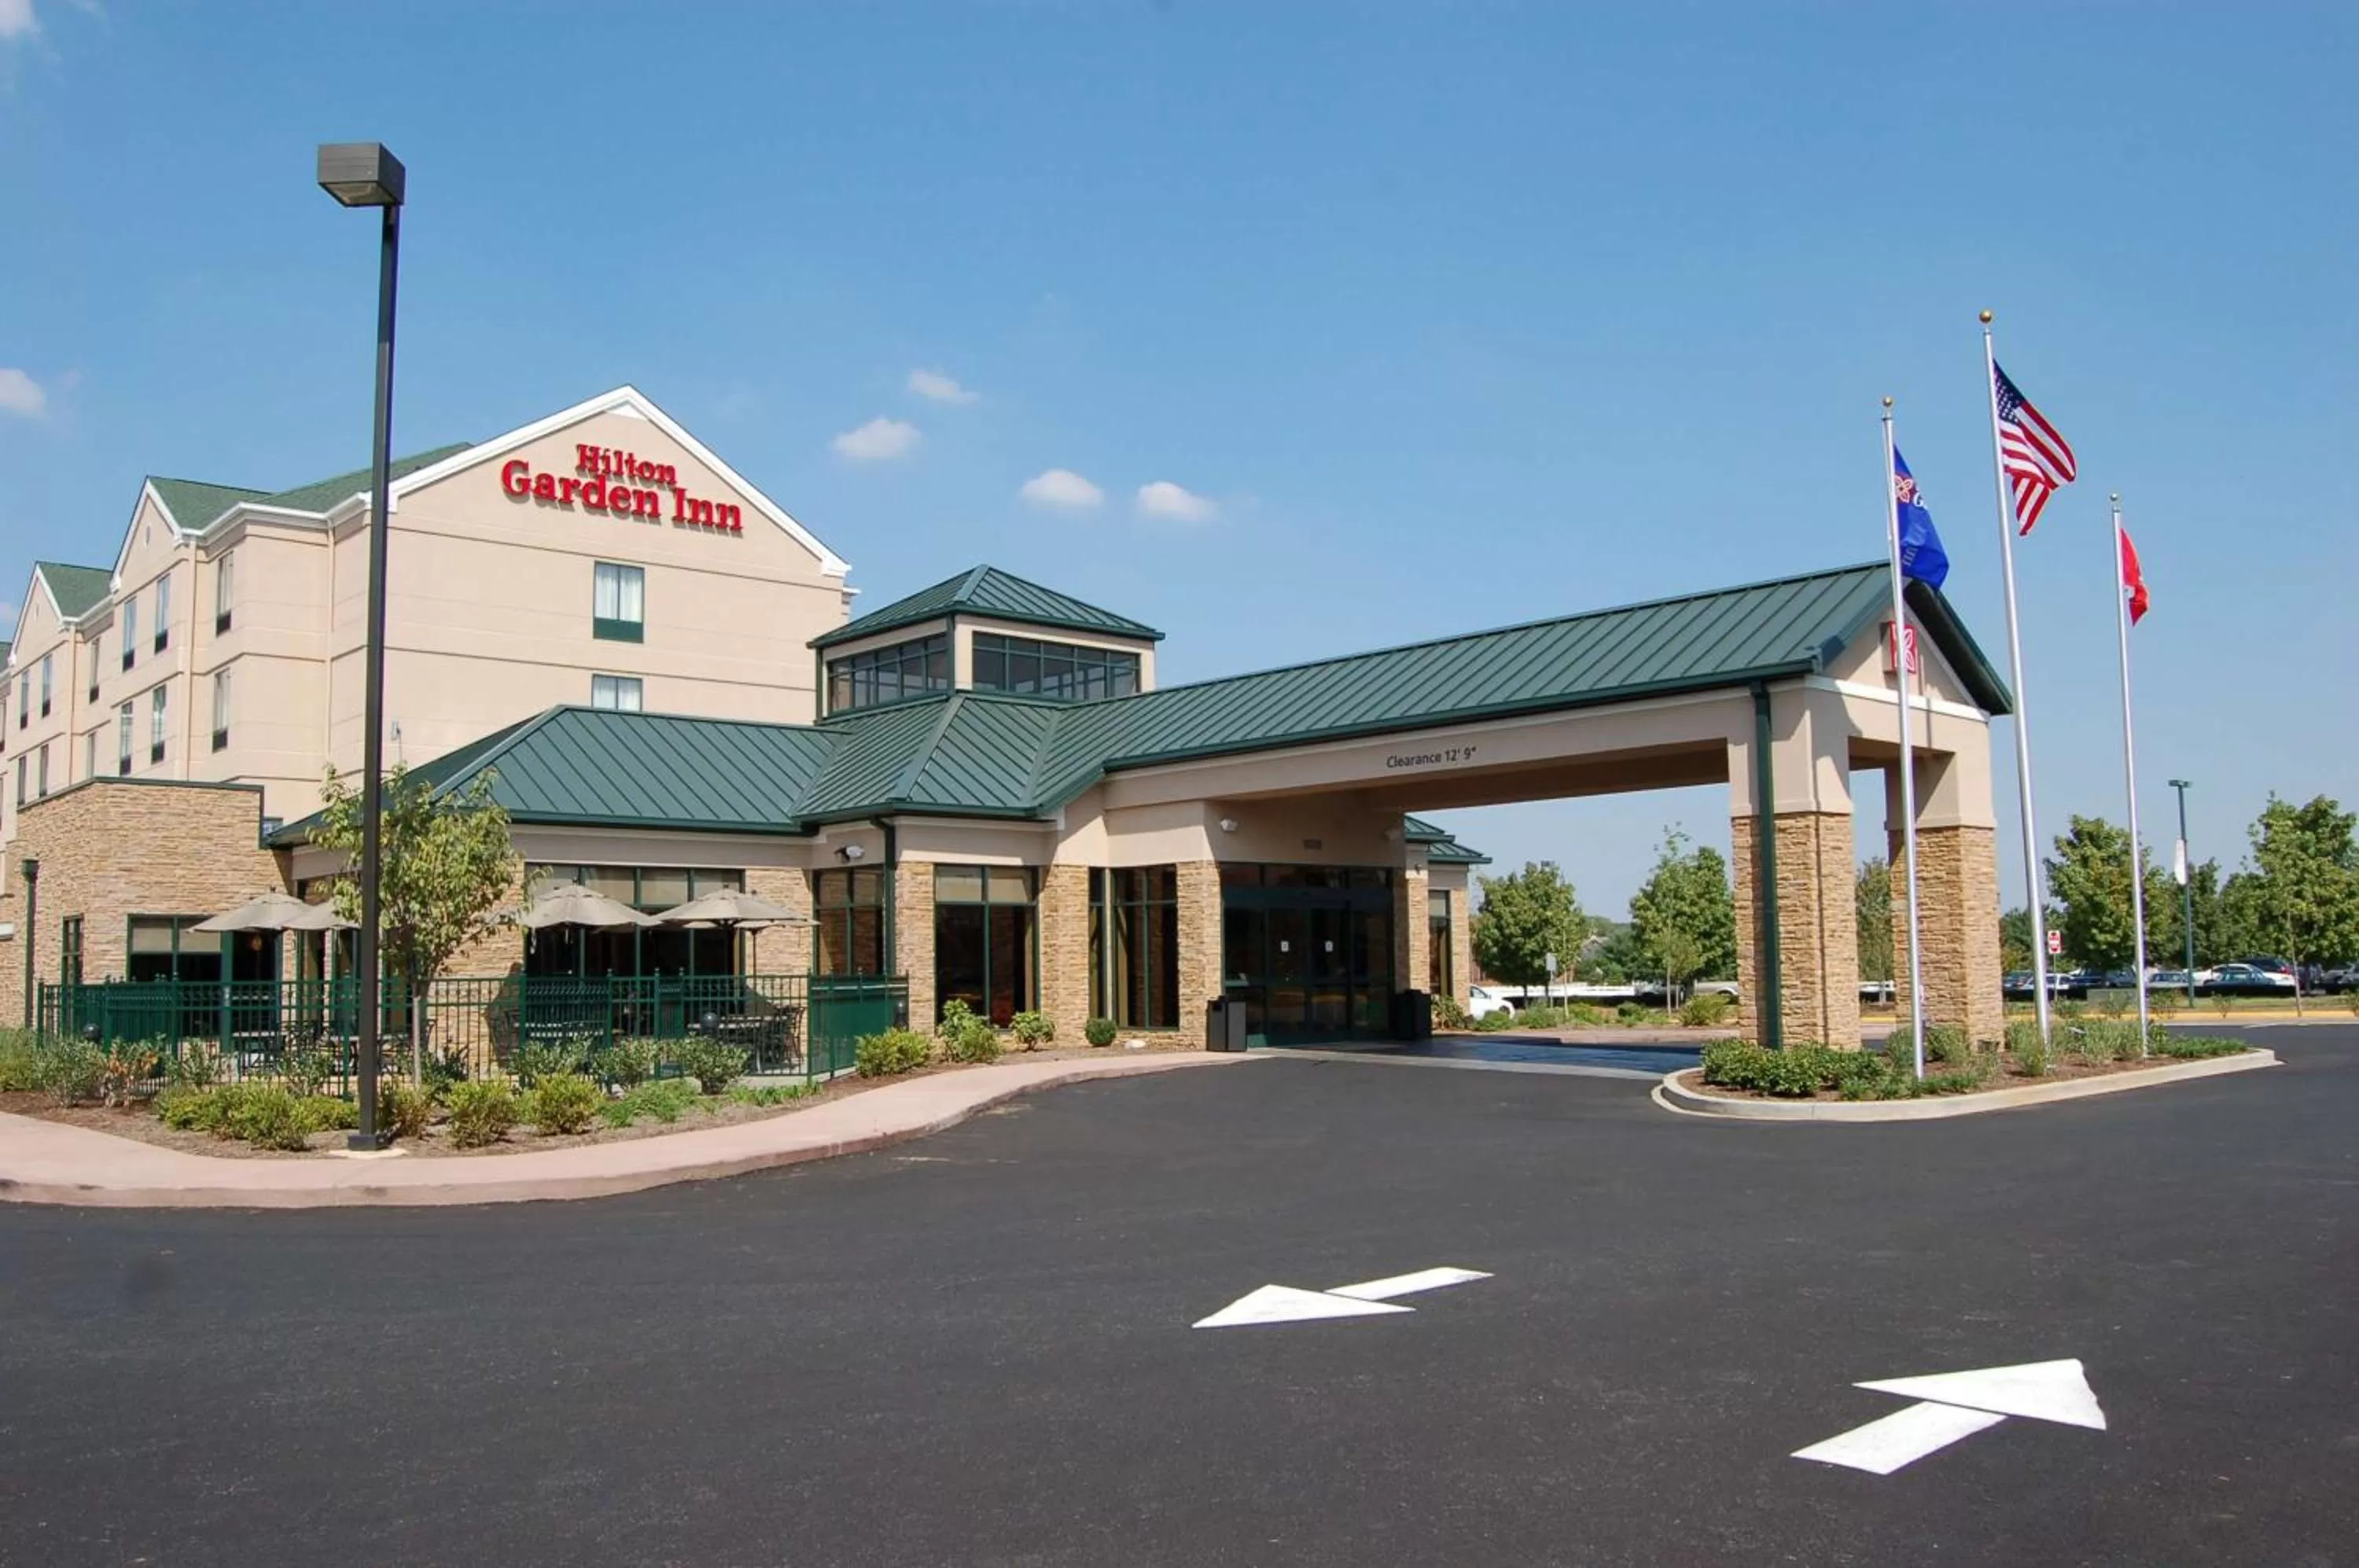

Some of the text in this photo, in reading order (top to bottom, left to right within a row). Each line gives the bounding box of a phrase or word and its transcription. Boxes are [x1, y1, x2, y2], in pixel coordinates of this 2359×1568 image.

[576, 444, 677, 485] Hilton
[501, 459, 743, 532] Garden Inn
[1386, 753, 1441, 768] Clearance
